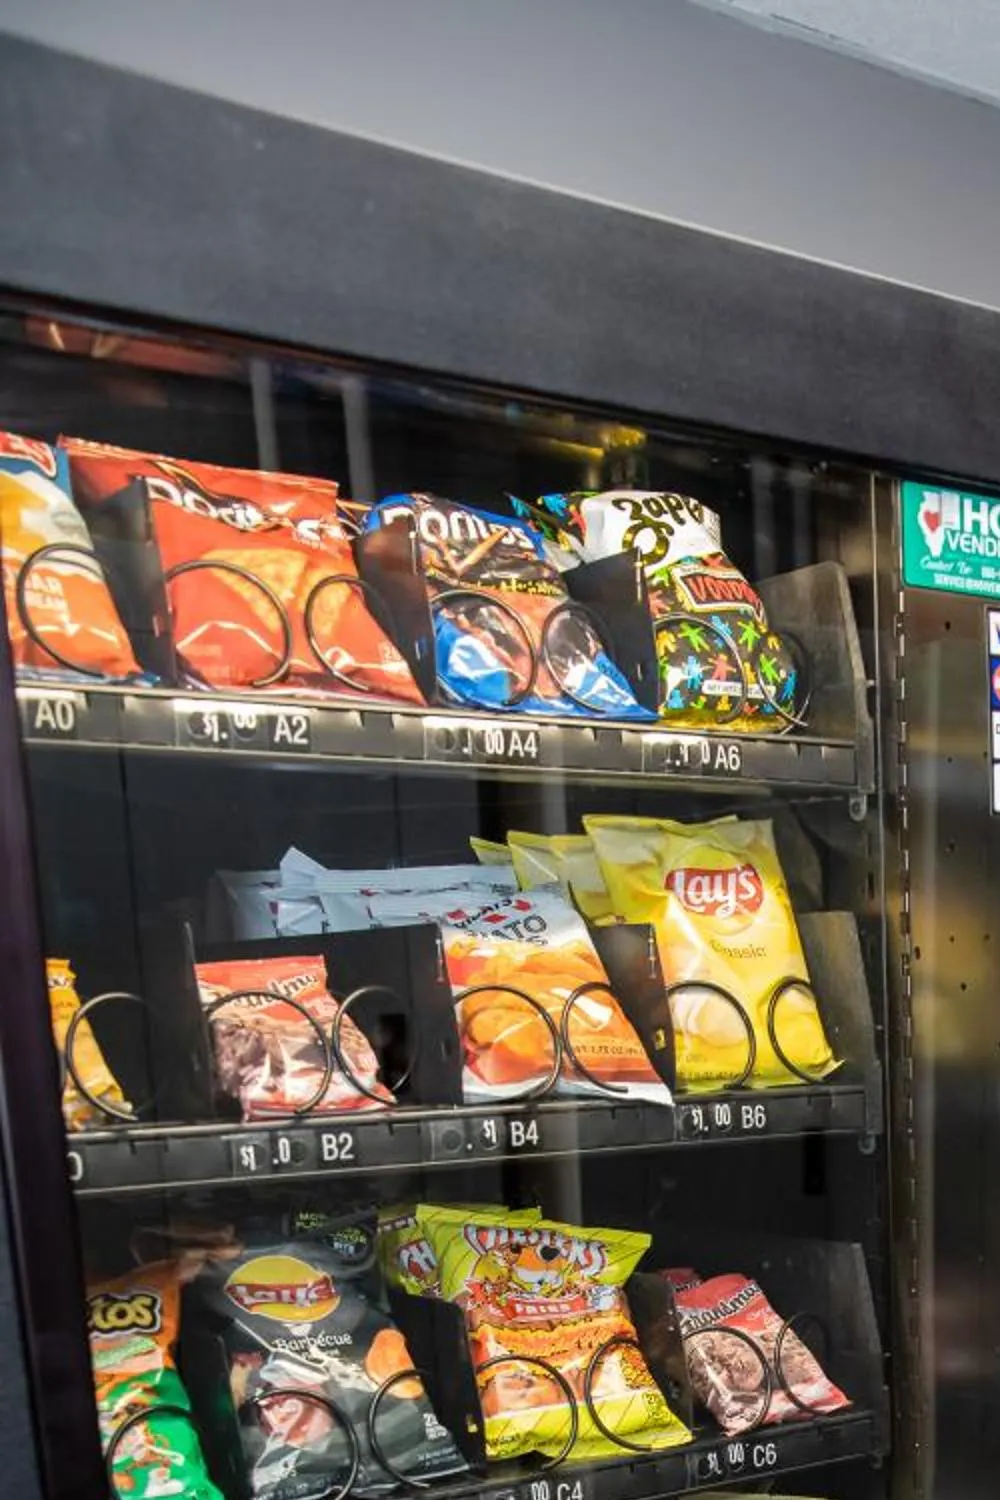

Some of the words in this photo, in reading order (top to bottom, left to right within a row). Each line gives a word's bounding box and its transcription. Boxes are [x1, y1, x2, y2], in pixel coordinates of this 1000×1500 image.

[34, 701, 75, 731] A0
[273, 714, 309, 745] A2
[508, 731, 539, 758] A4
[714, 745, 742, 771] A6
[672, 865, 758, 919] Lay's
[741, 1105, 767, 1128] B6
[321, 1133, 355, 1161] B2
[510, 1121, 539, 1146] B4
[236, 1279, 330, 1311] Lay's
[753, 1443, 777, 1467] C6
